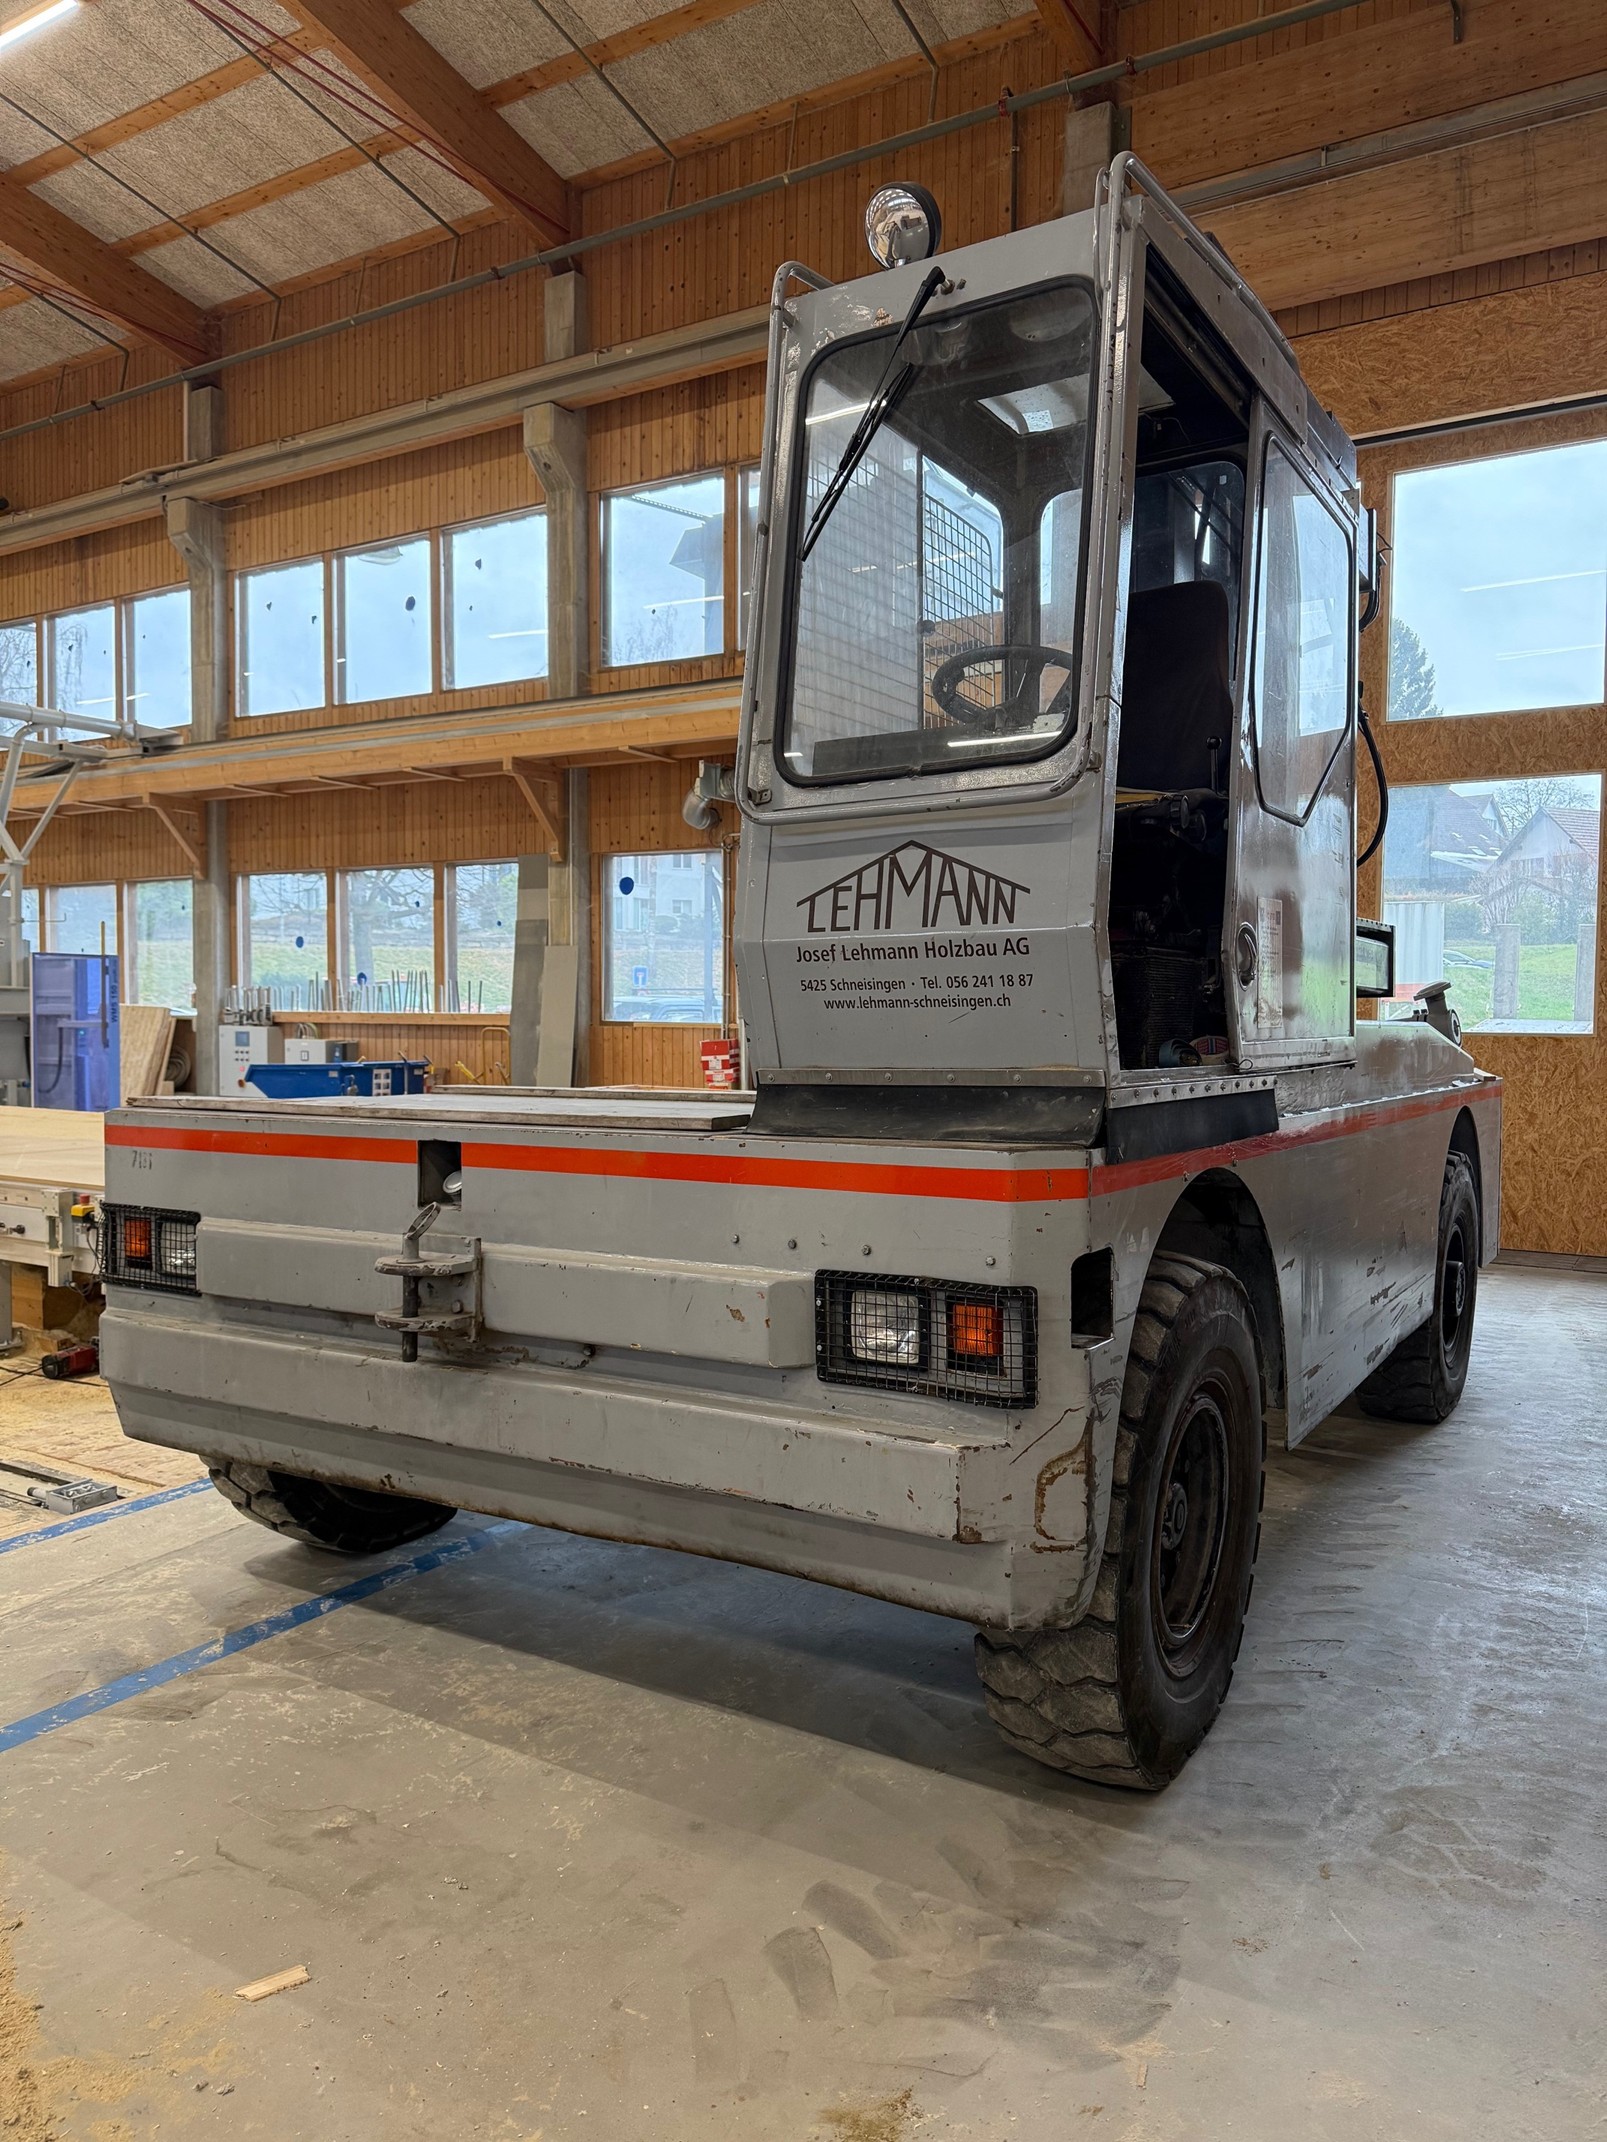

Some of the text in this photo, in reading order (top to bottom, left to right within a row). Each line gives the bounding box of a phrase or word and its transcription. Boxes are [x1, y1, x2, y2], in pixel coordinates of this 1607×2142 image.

[796, 839, 1031, 933] LEHMANN
[796, 936, 1031, 964] Josef Lehmann Holzbau AG
[800, 973, 1034, 994] 5425 Schneisingen Tel. 056 241 18 87
[823, 993, 1012, 1011] www.lehmann-schneisingen.ch
